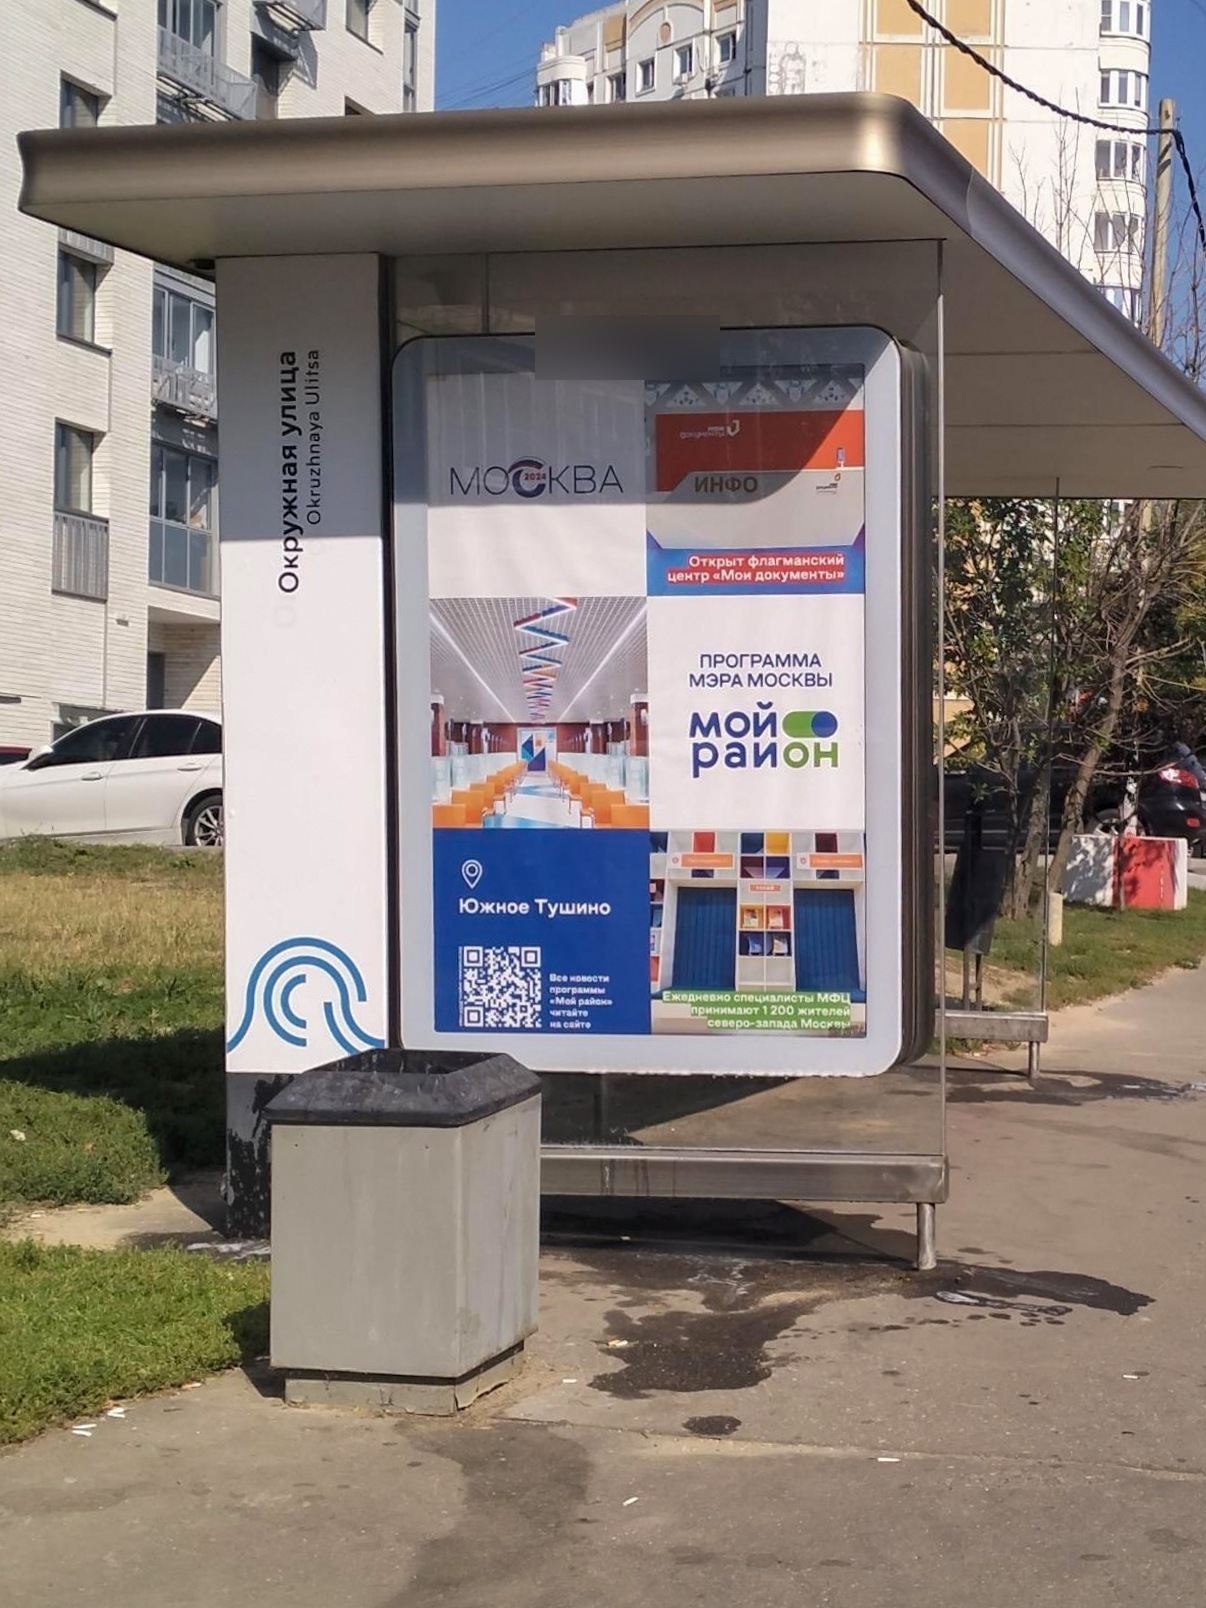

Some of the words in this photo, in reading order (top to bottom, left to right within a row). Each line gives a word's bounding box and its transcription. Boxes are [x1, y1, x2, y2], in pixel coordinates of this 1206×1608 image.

[304, 350, 320, 405] Ulitsa
[281, 351, 302, 437] улица
[306, 411, 323, 525] Okruzhnaya
[450, 456, 624, 498] МОСКВА
[524, 472, 547, 481] 2024
[694, 475, 758, 493] ИНФО
[278, 445, 303, 593] Окружная
[688, 555, 744, 569] Открыт
[748, 553, 844, 569] флагманский
[667, 570, 710, 583] центр
[713, 569, 752, 581] «Мои
[755, 569, 844, 583] документы»
[700, 653, 822, 669] ПРОГРАММА
[689, 673, 743, 688] МЭРА
[748, 672, 833, 688] МОСКВЫ
[689, 701, 778, 739] мой
[458, 898, 530, 915] Южное
[534, 898, 612, 919] Тушино
[549, 973, 569, 983] Все
[570, 974, 610, 983] новости
[549, 986, 606, 995] программы
[662, 991, 731, 1003] Ежедневно
[733, 992, 814, 1004] специалисты
[817, 992, 851, 1004] МФЦ
[549, 1008, 589, 1017] читайте
[691, 1005, 760, 1016] принимают
[798, 1004, 851, 1017] жителей
[550, 1020, 562, 1028] на
[563, 1019, 592, 1029] сайте
[707, 1018, 798, 1029] северо-запада
